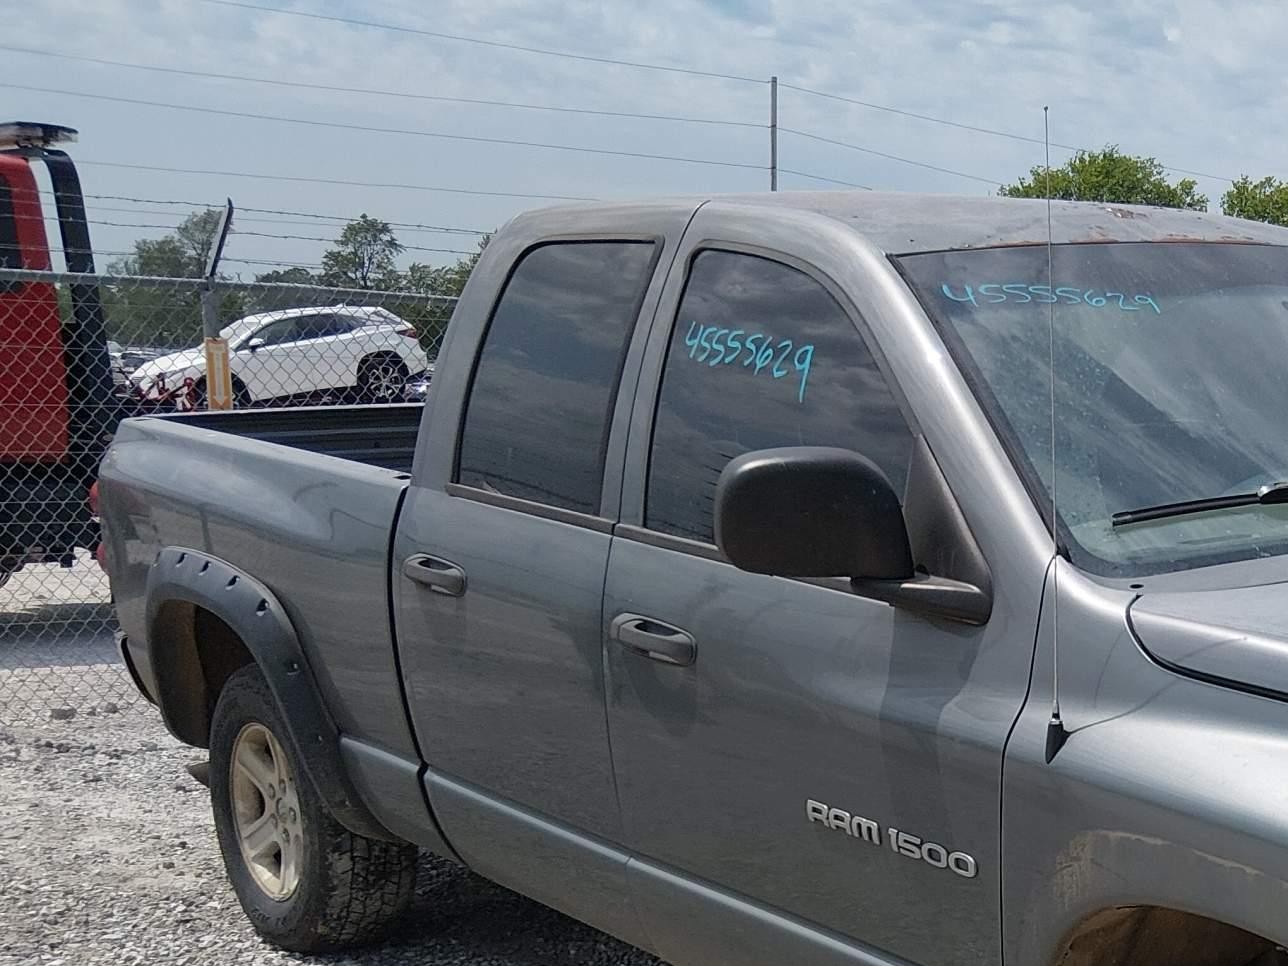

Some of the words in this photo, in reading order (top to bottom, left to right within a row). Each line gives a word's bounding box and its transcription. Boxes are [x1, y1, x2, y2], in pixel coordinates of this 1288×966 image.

[942, 284, 1160, 314] 45555629
[685, 321, 814, 403] 45555629
[806, 799, 881, 845] RAM
[888, 827, 977, 878] 1500
